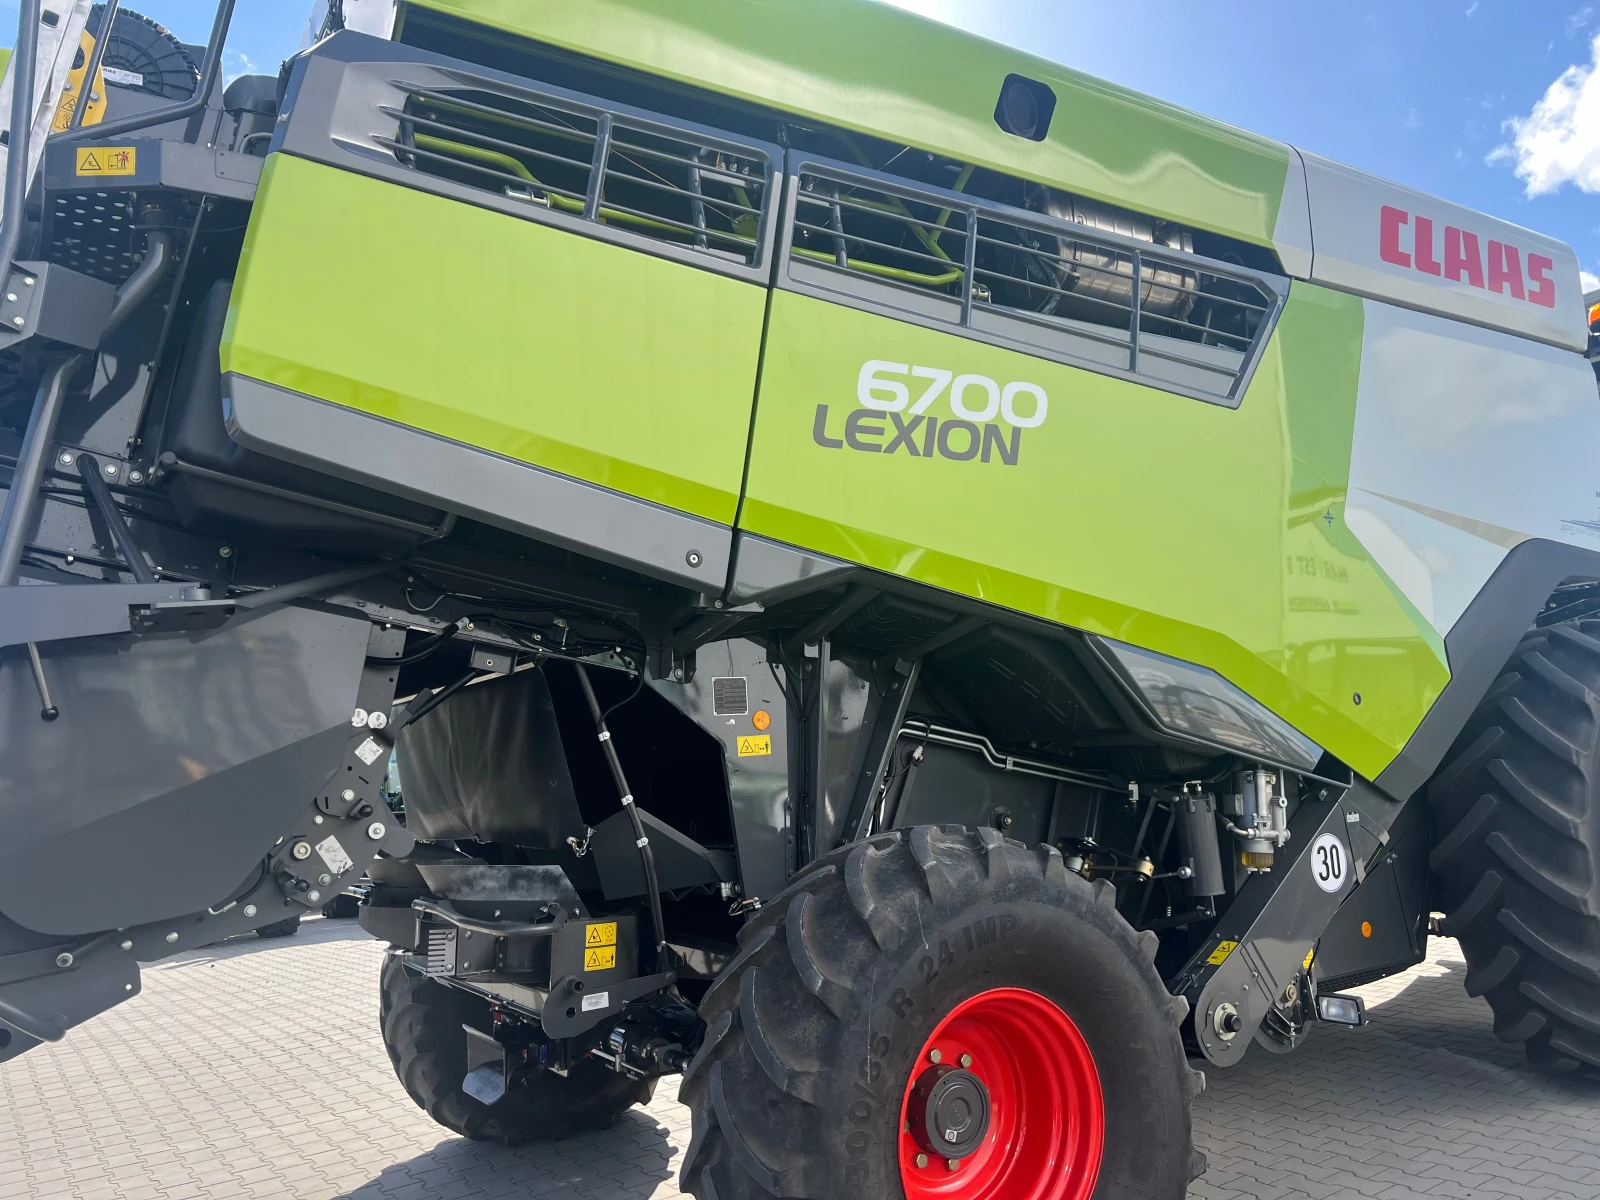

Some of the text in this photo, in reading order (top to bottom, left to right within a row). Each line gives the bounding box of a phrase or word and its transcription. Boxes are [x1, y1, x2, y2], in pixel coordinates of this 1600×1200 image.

[1380, 205, 1555, 308] CLAAS
[857, 360, 1048, 428] 6700
[813, 404, 1021, 466] LEXION
[1317, 844, 1341, 881] 30
[886, 986, 915, 1020] R
[917, 938, 955, 988] 24
[962, 913, 1021, 952] IMP
